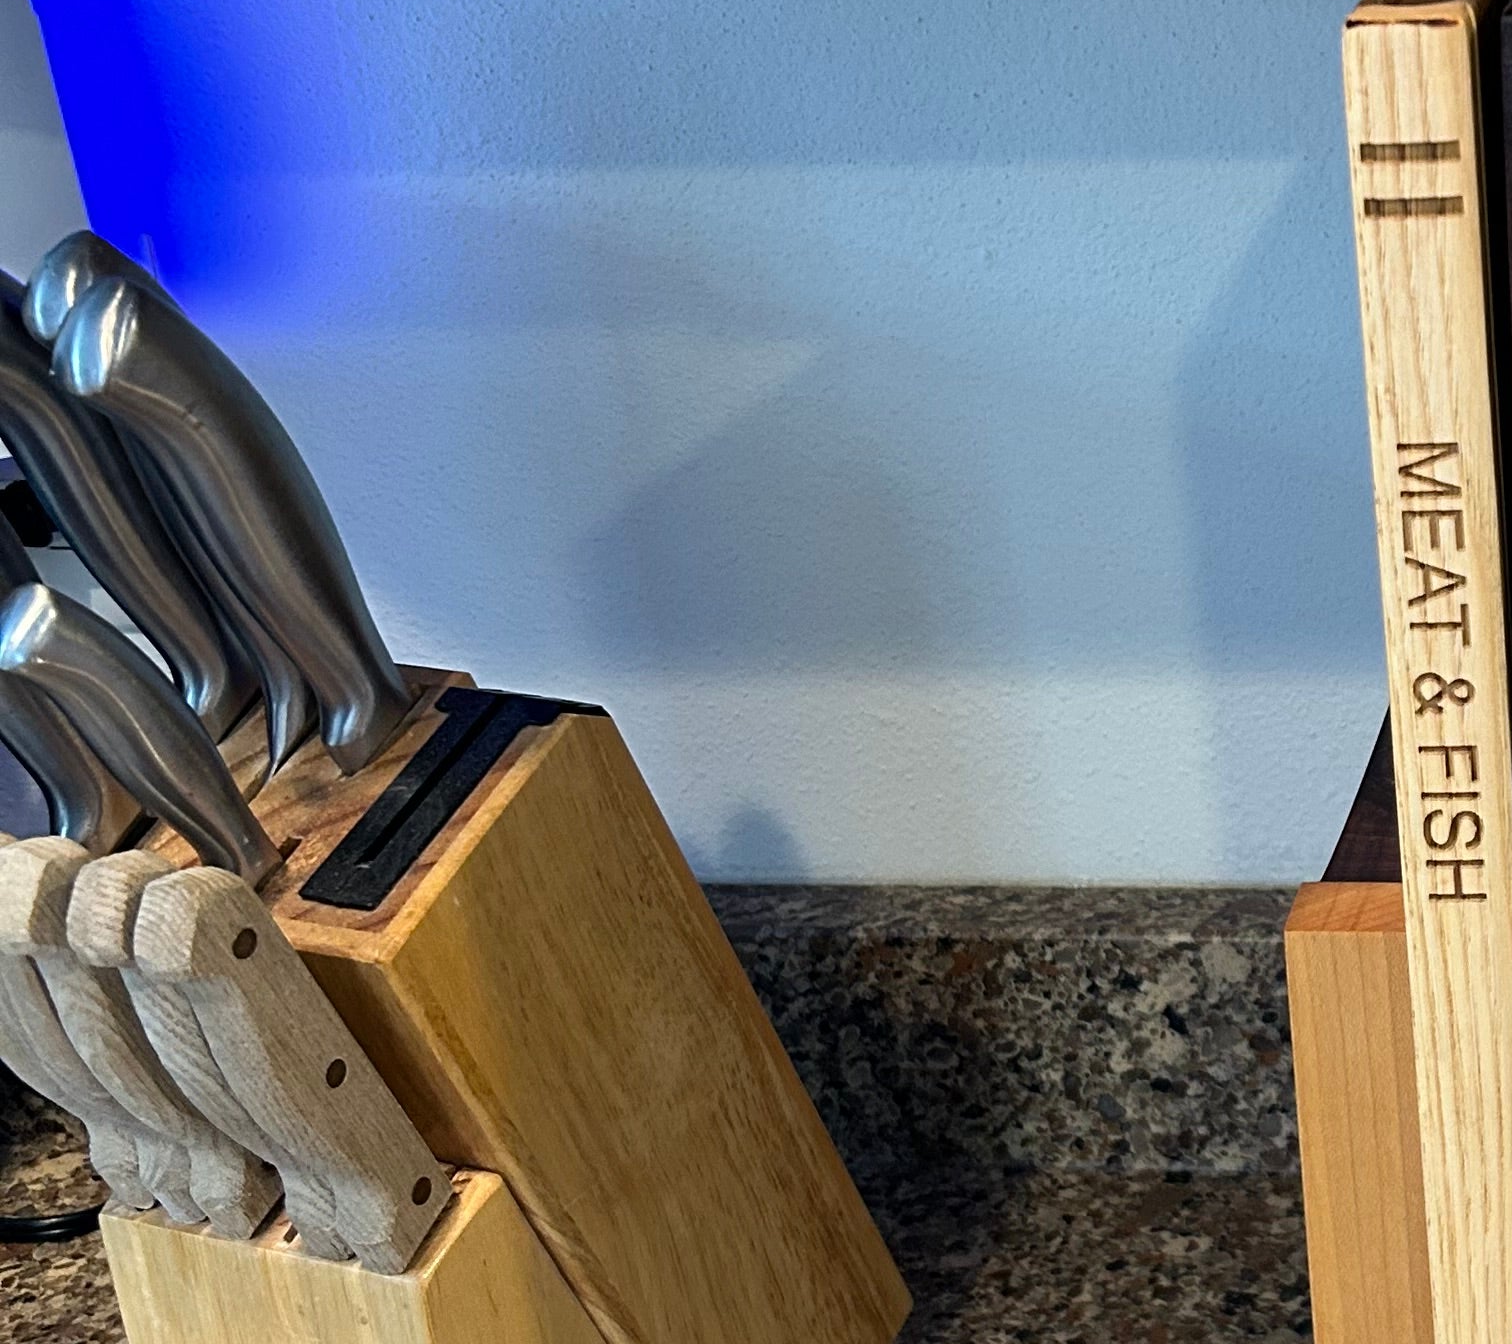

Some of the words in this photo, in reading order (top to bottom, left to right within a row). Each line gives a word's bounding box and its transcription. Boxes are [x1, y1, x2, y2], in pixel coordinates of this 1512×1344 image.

[1397, 442, 1470, 647] MEAT
[1413, 671, 1475, 717] &
[1418, 742, 1487, 904] FISH
